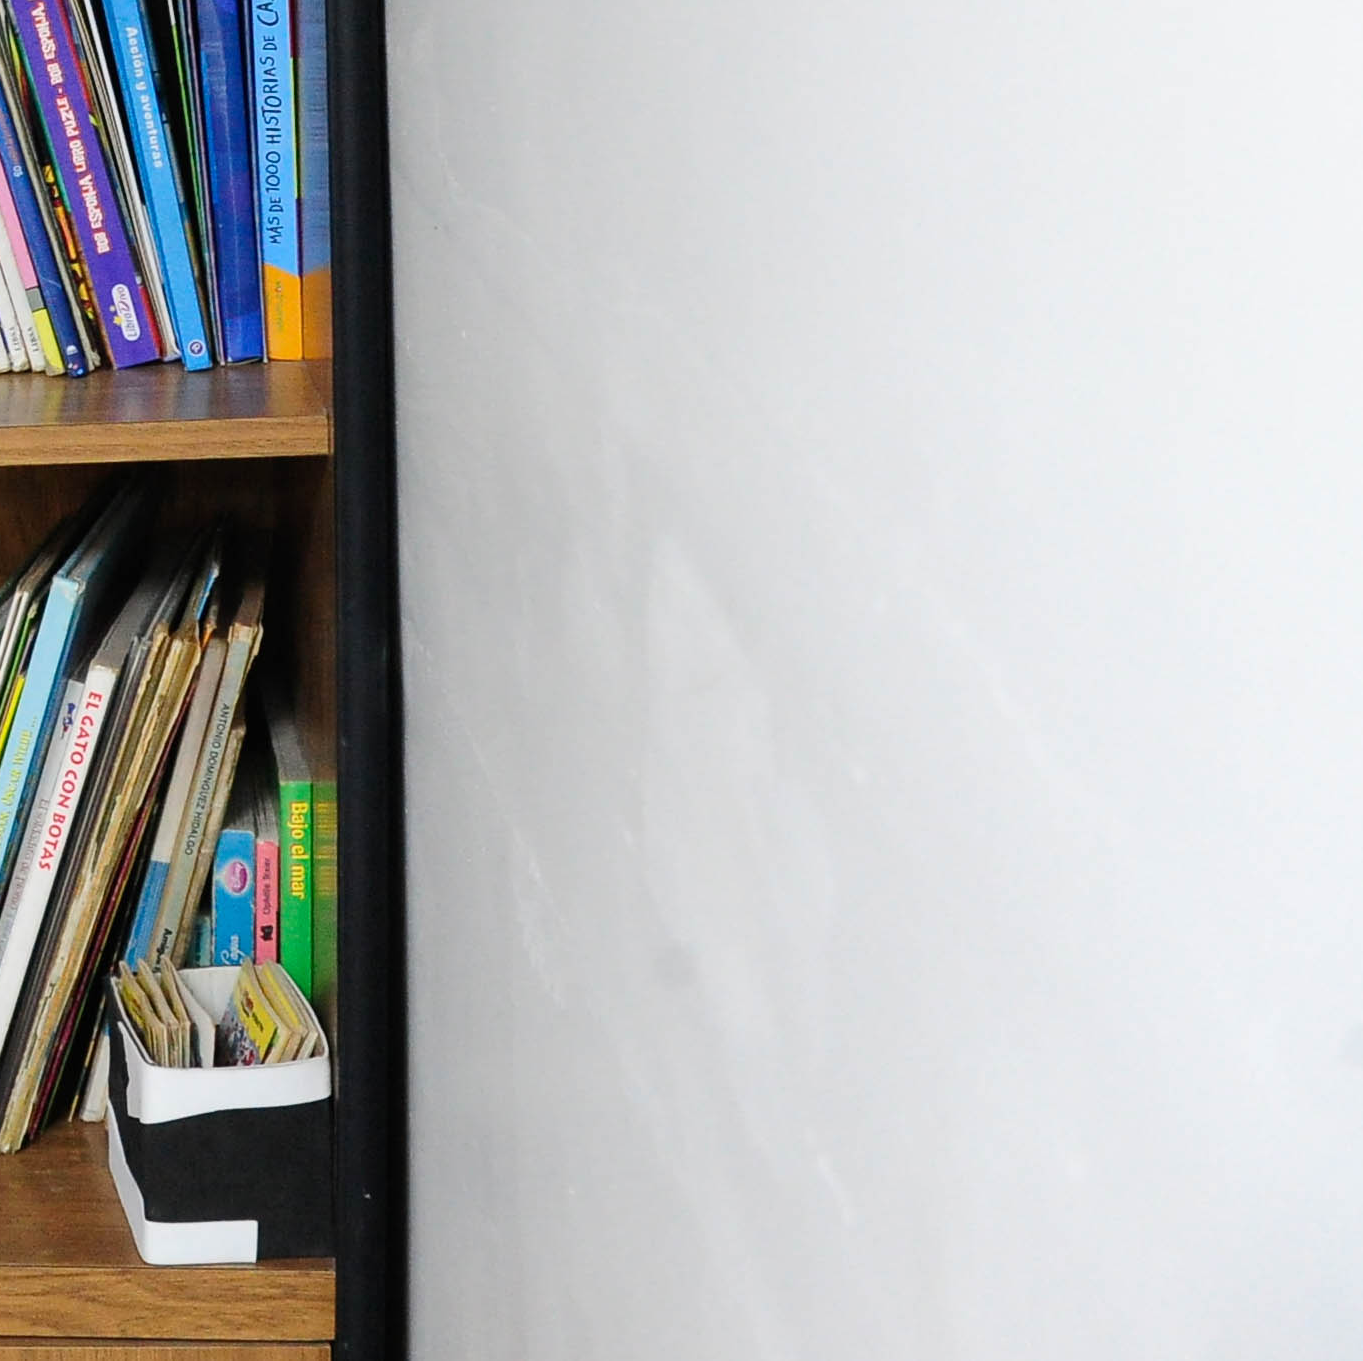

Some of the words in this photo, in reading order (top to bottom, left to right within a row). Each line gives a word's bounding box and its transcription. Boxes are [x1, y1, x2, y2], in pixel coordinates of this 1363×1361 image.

[124, 25, 147, 78] Acción
[261, 34, 277, 51] DE
[45, 60, 65, 86] BOB
[134, 81, 147, 91] y
[54, 94, 80, 138] PUZLE
[260, 55, 282, 144] HISTORIAS
[138, 92, 165, 169] aventuras
[67, 138, 89, 173] LIBRO
[264, 150, 281, 191] 1000
[77, 173, 106, 229] ESPONJA
[268, 197, 283, 212] DE
[92, 229, 112, 254] BOB
[265, 216, 284, 244] MÁS
[83, 690, 103, 712] EL
[67, 714, 96, 766] GATO
[210, 702, 232, 749] ANTONIO
[54, 768, 80, 809] CON
[181, 810, 202, 856] HIDALGO
[285, 801, 308, 839] Bajo
[36, 811, 67, 871] BOTAS
[290, 843, 308, 859] el
[289, 863, 307, 900] mar
